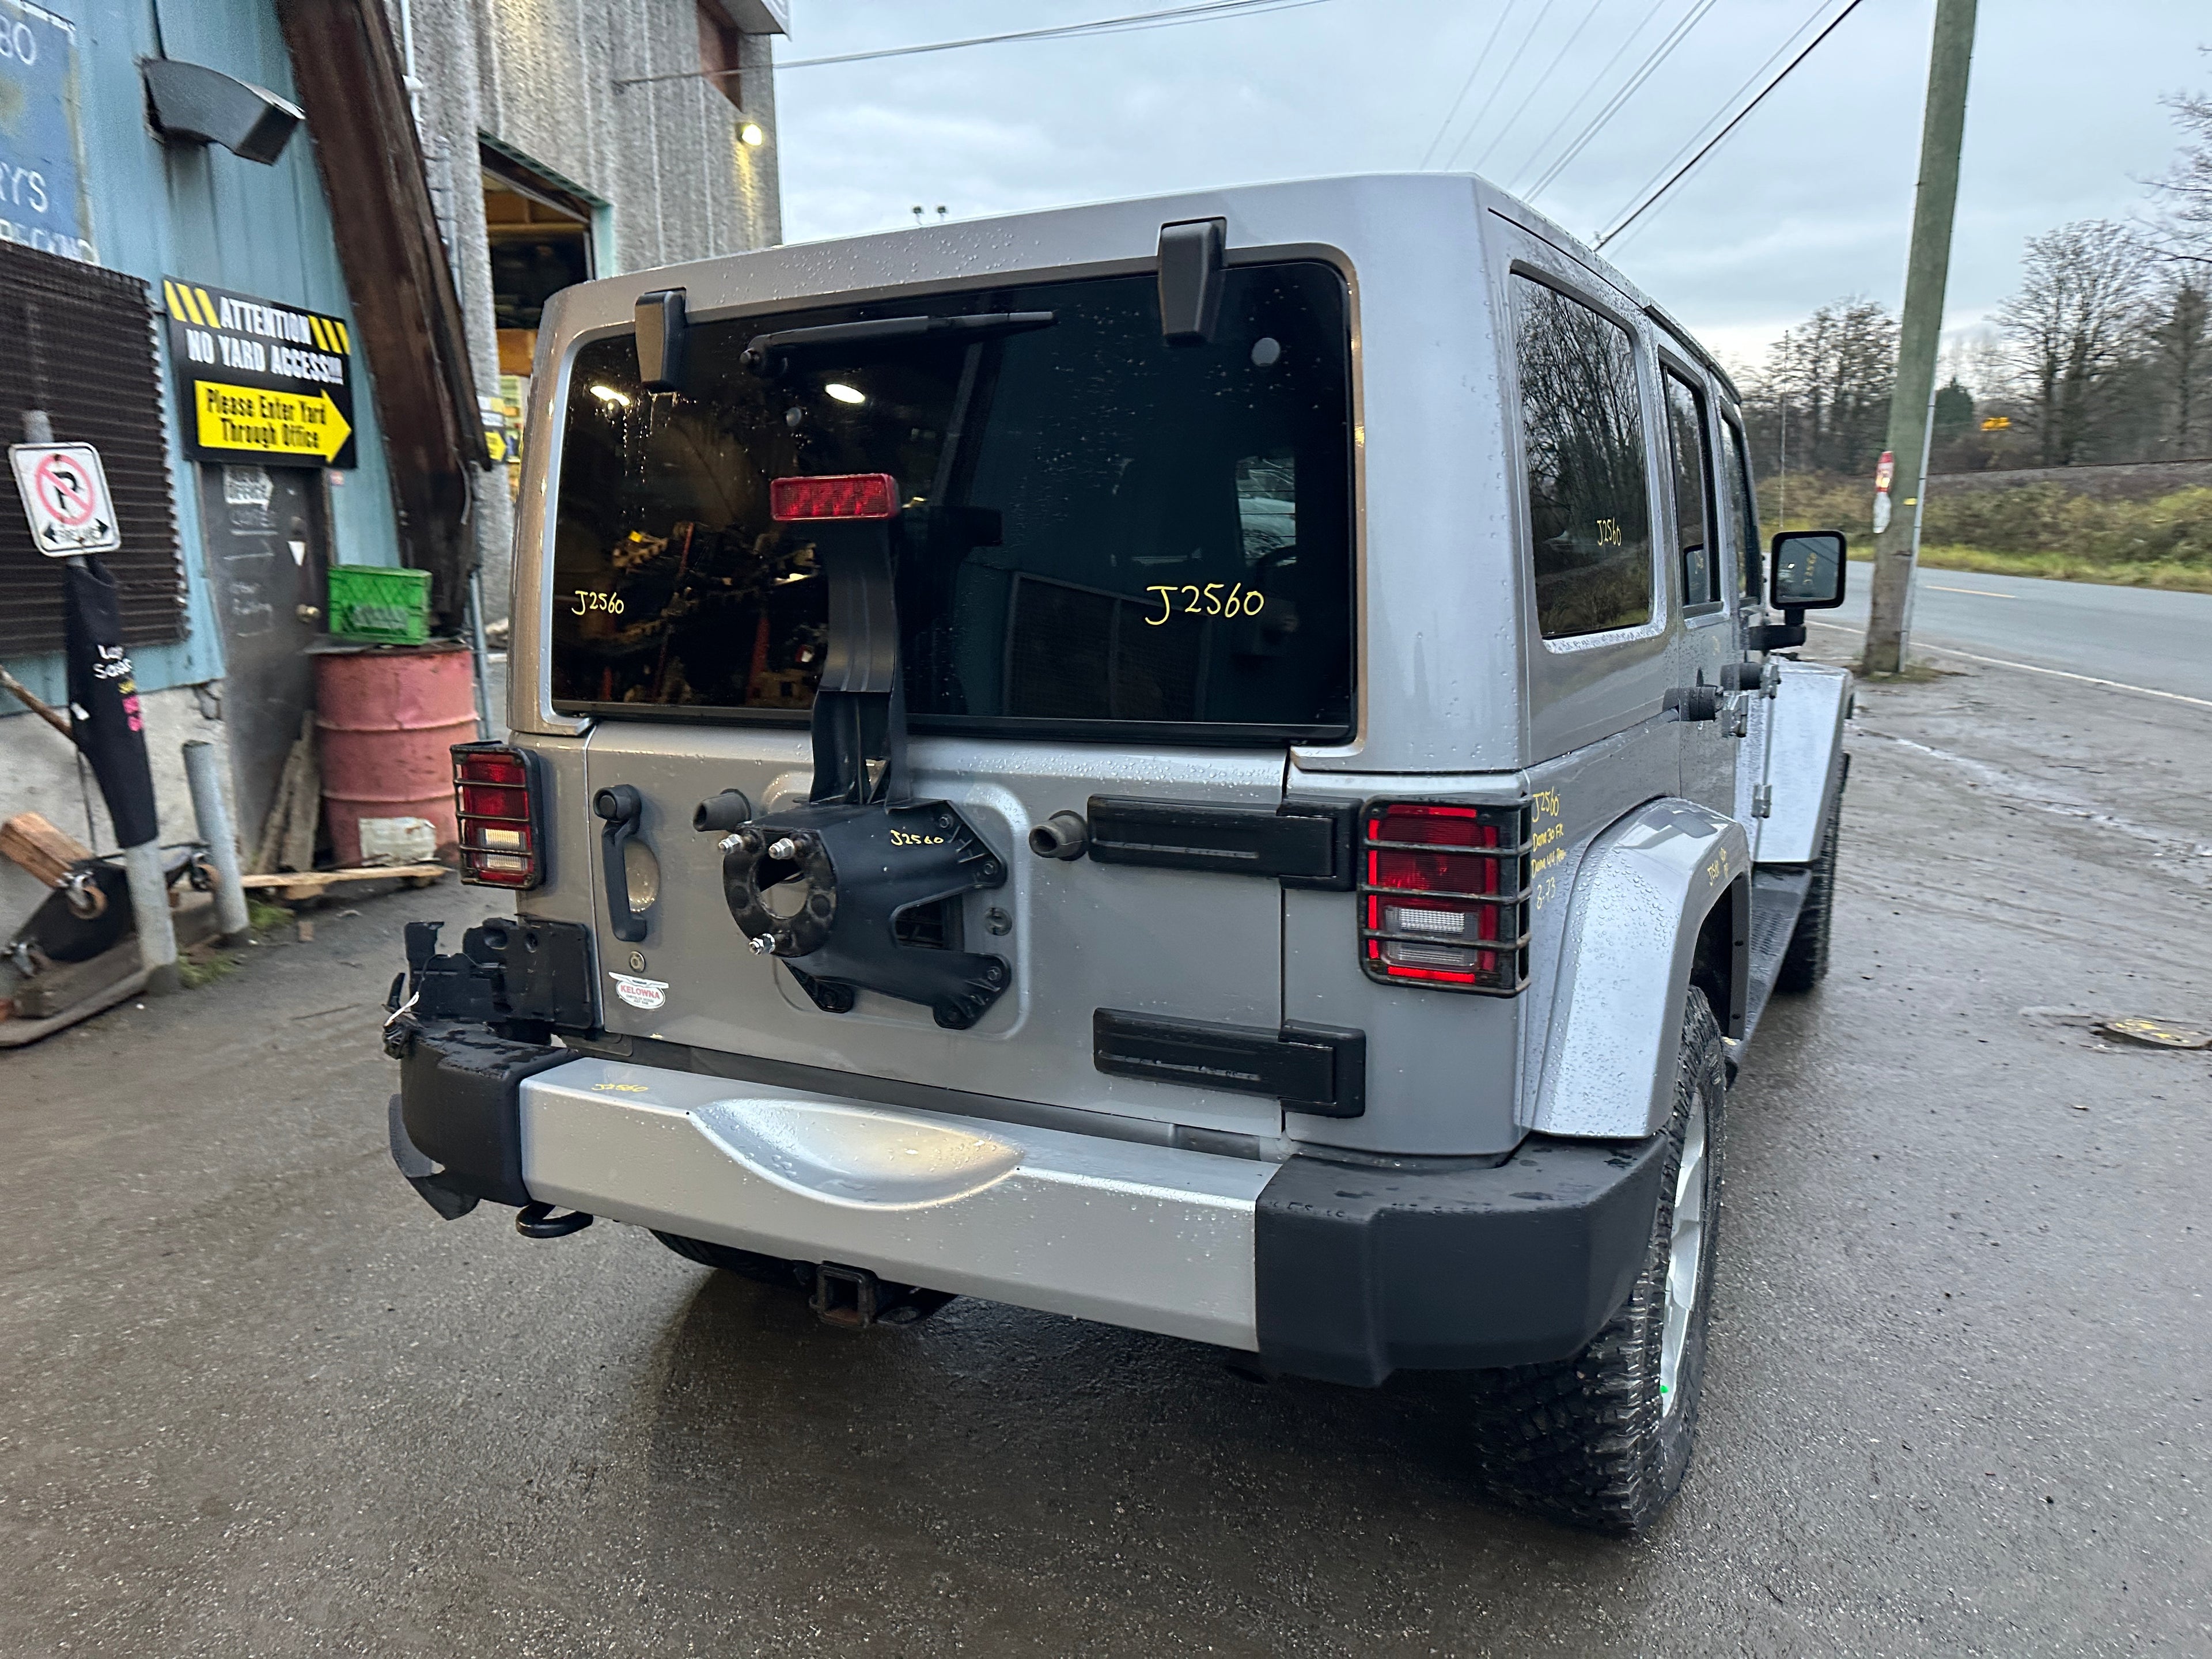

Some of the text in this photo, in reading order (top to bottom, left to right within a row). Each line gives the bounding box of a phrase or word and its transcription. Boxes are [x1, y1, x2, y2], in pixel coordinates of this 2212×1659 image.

[220, 296, 312, 345] ATTENTION
[185, 328, 215, 365] NO
[217, 334, 266, 372] YARD
[206, 388, 327, 425] Please Enter Yard
[219, 417, 319, 449] Through Office
[1596, 517, 1622, 547] J2560
[571, 590, 624, 616] J2560
[1145, 582, 1264, 626] J2560
[1532, 786, 1560, 823] J2560
[890, 830, 944, 846] J2560
[620, 984, 661, 1000] KELOWNA
